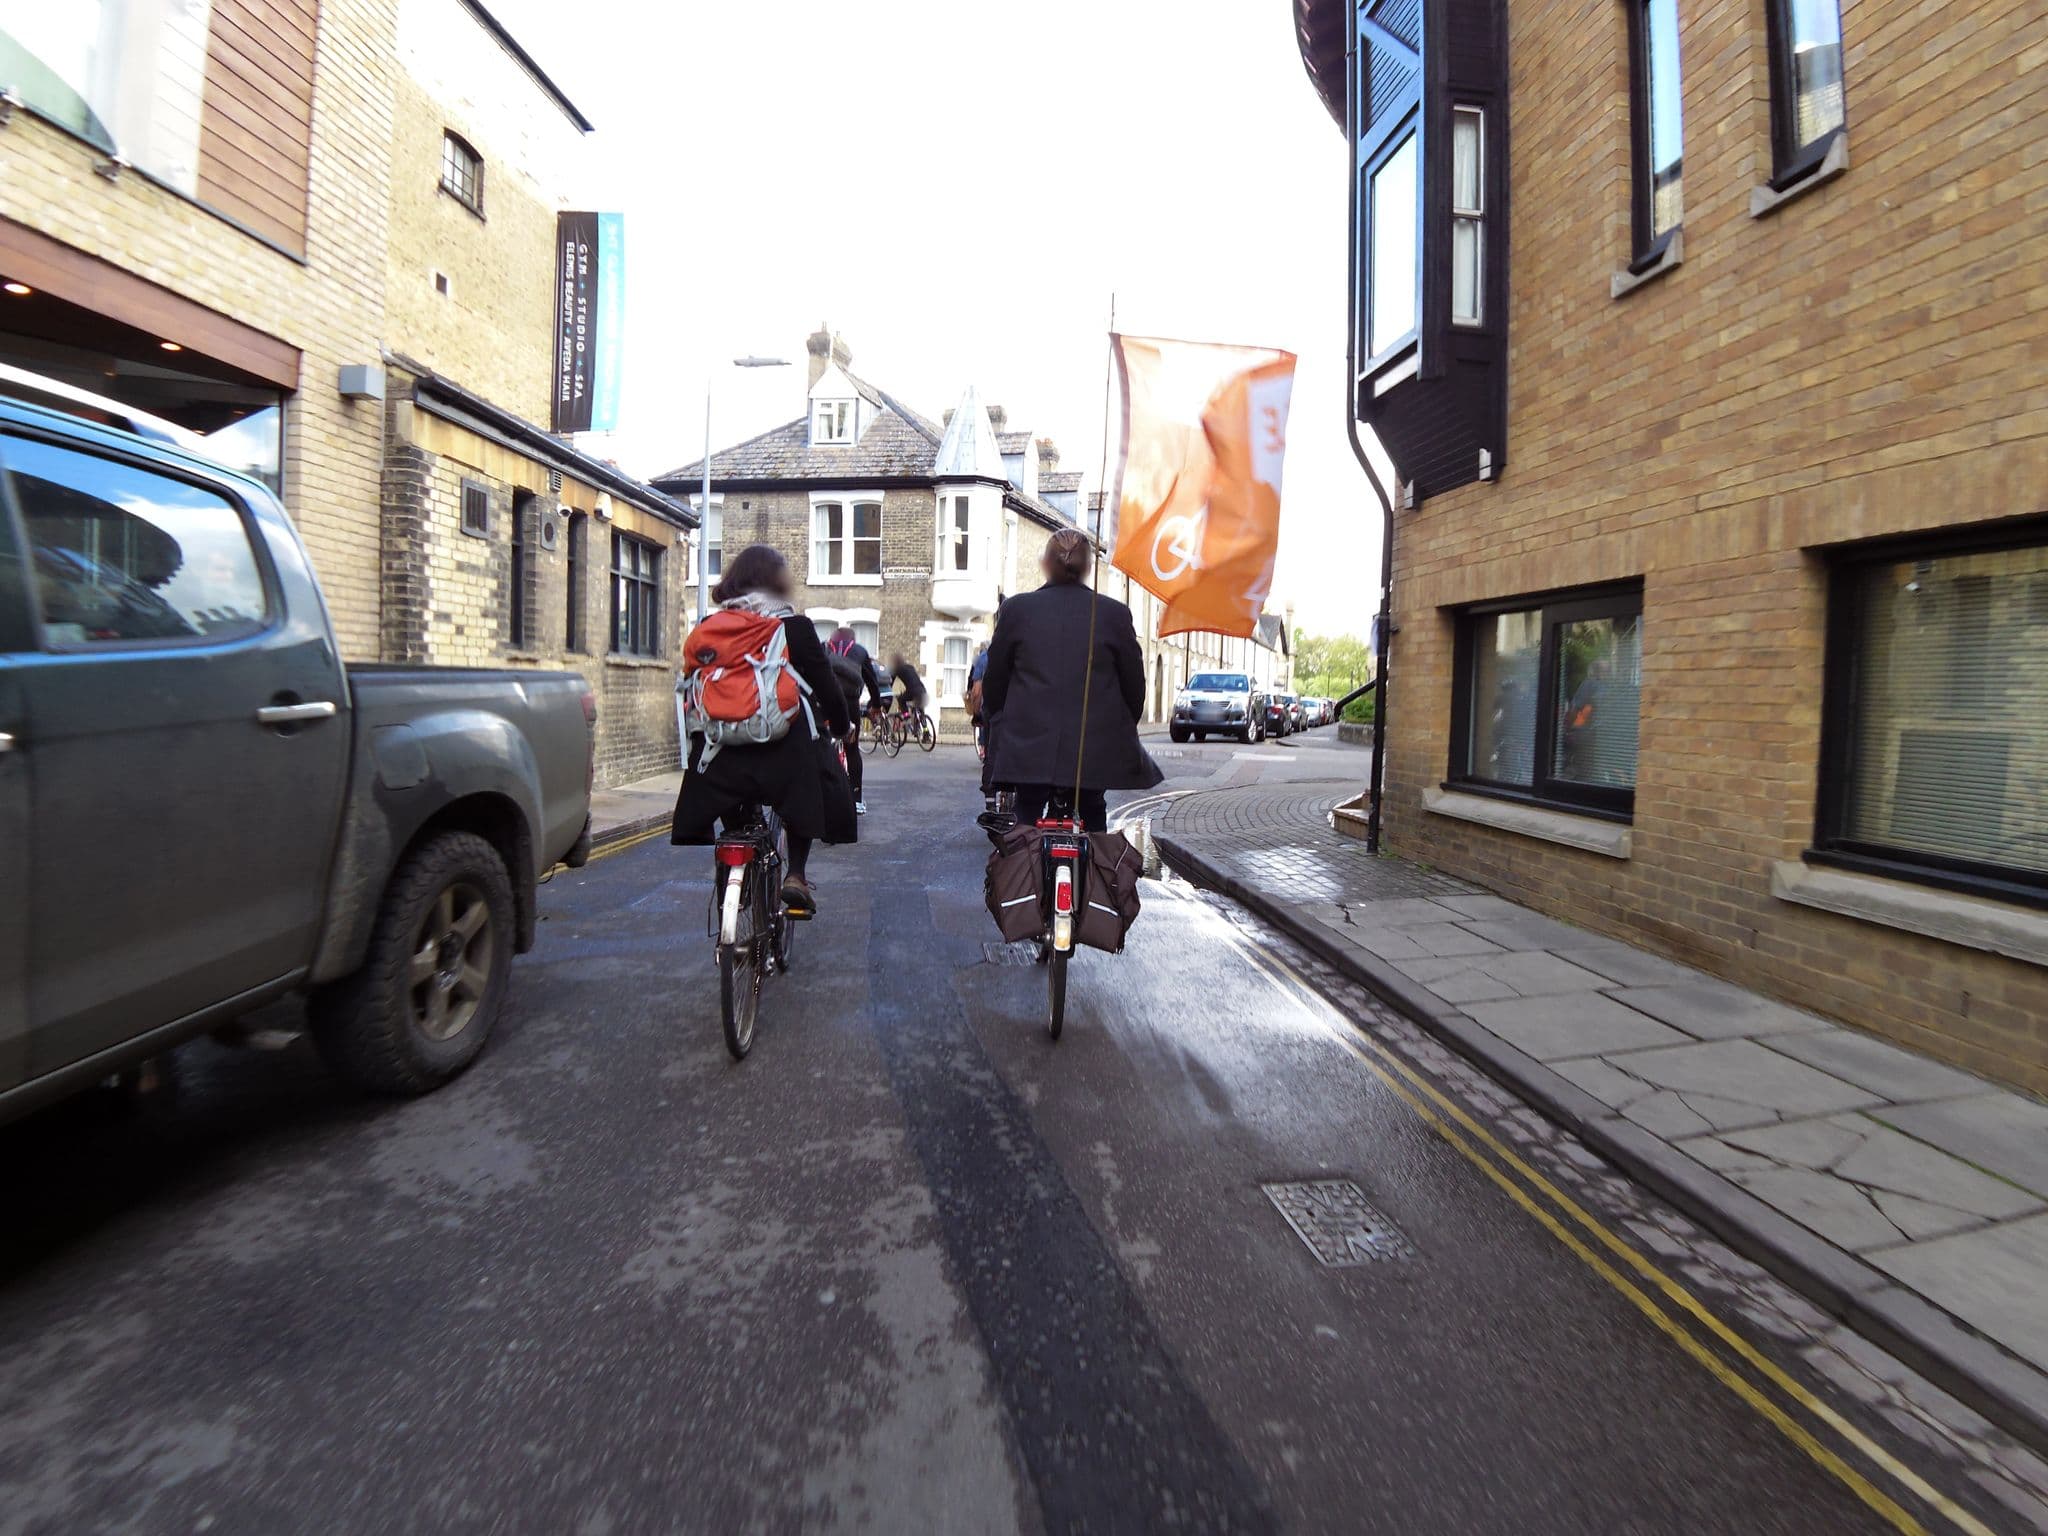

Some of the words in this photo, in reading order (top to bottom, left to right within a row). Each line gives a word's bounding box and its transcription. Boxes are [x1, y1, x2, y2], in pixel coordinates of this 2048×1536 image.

[565, 241, 575, 280] ELEMIS
[578, 243, 588, 275] GYM
[564, 281, 574, 325] BEAUTY
[576, 297, 587, 352] STUDIO
[562, 337, 572, 372] AVEDA
[562, 375, 571, 402] HAIR
[574, 374, 584, 399] SPA
